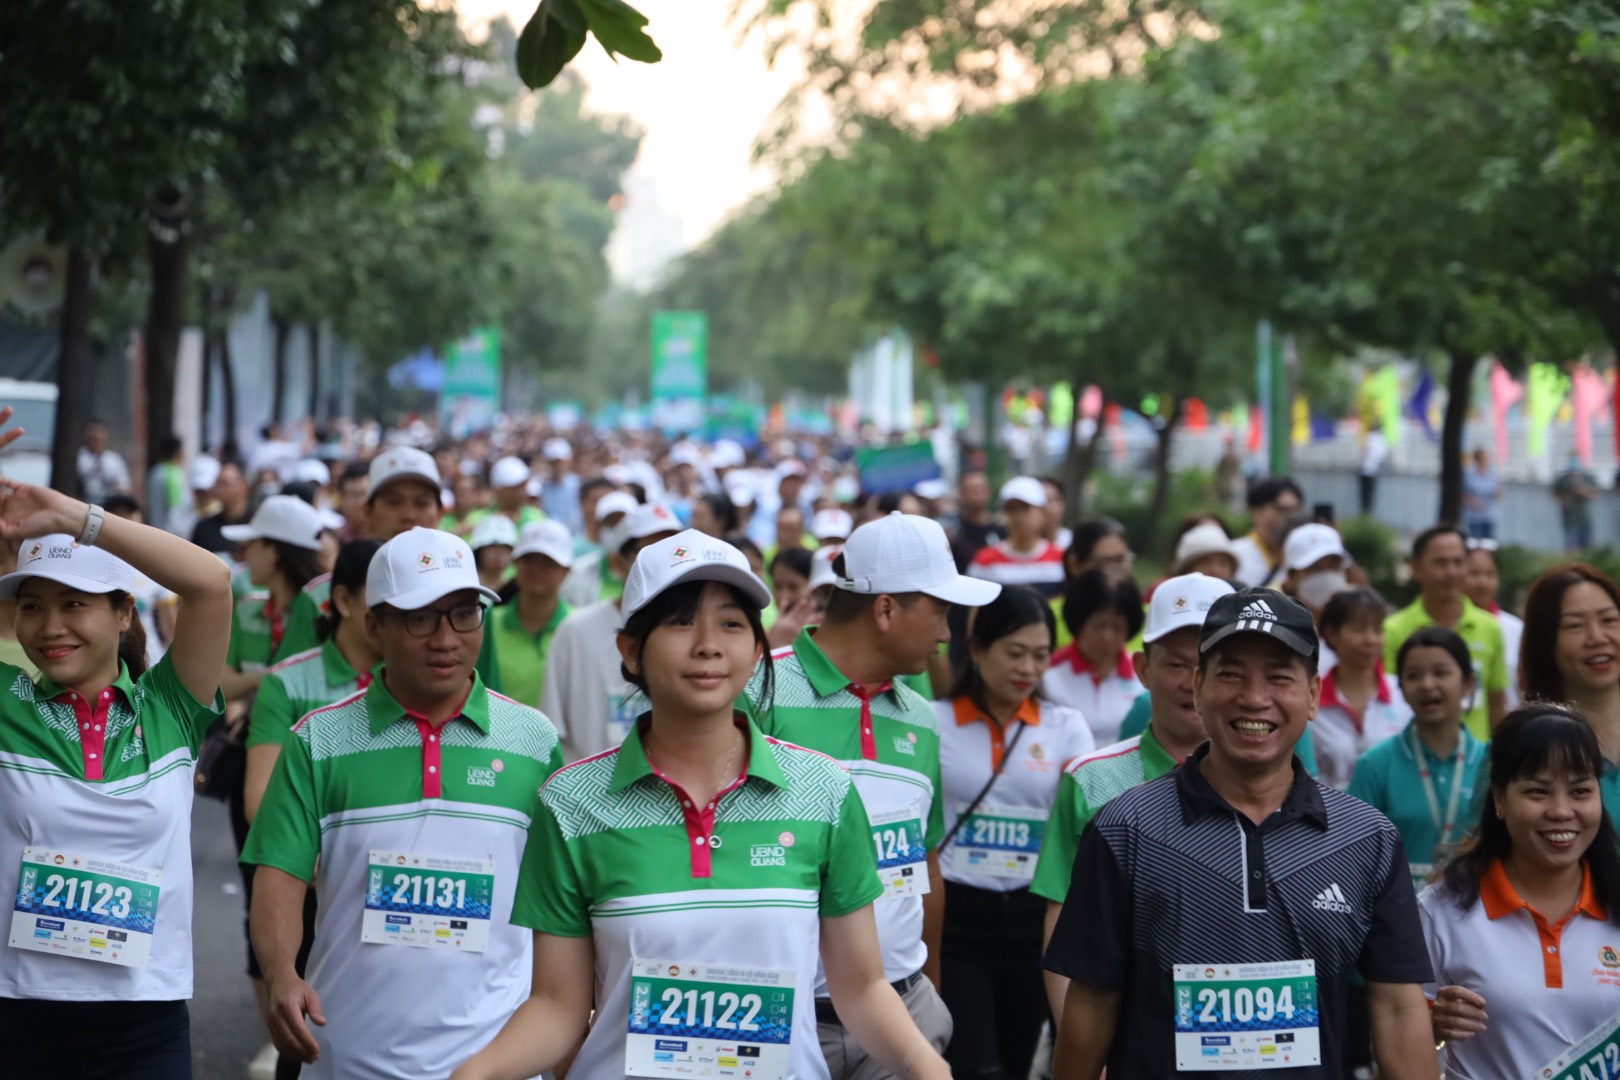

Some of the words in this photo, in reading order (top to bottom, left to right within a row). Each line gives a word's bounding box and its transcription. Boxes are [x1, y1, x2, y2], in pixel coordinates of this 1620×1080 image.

[1238, 609, 1278, 621] adidas
[467, 768, 496, 779] UBND
[973, 819, 1030, 847] 21113
[750, 846, 786, 858] UBND
[42, 874, 132, 919] 21123
[391, 873, 467, 909] 21131
[1312, 899, 1352, 914] adidas
[659, 987, 763, 1032] 21122
[1198, 985, 1295, 1023] 21094
[1565, 1042, 1620, 1080] 472
